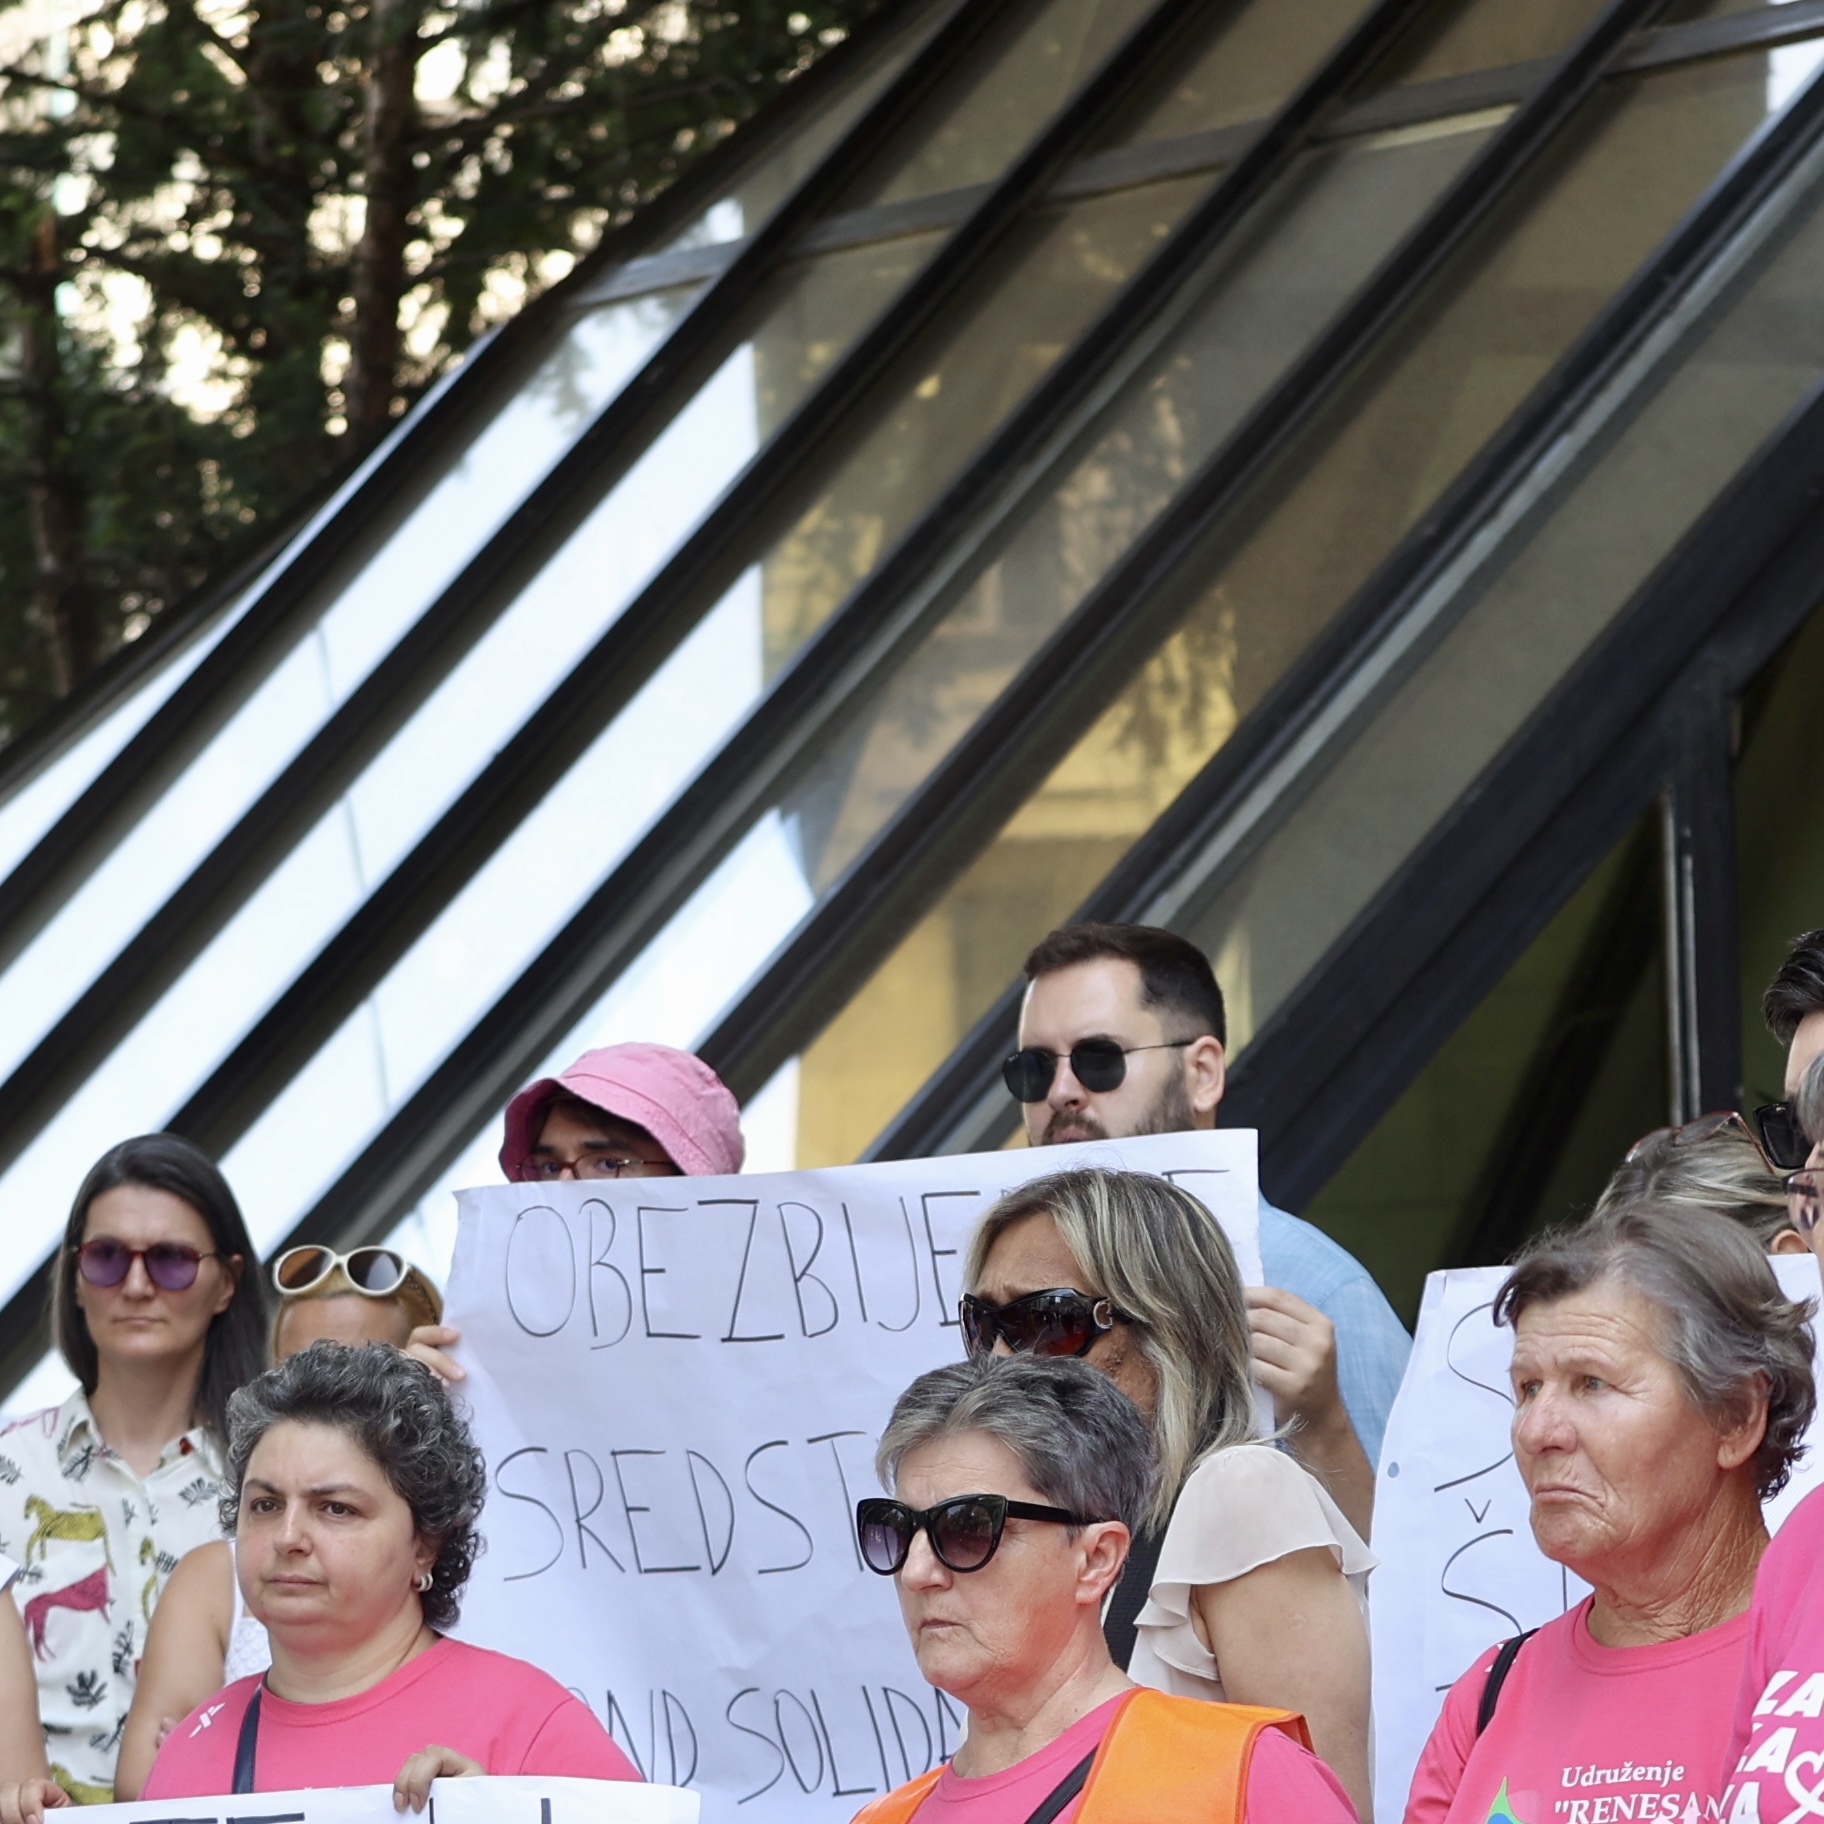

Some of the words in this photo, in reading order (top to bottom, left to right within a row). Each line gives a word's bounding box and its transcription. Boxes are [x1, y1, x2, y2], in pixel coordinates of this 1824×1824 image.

[494, 1430, 879, 1582] SREDST
[725, 1684, 964, 1805] SOLIDA
[1560, 1760, 1686, 1788] Udruženje
